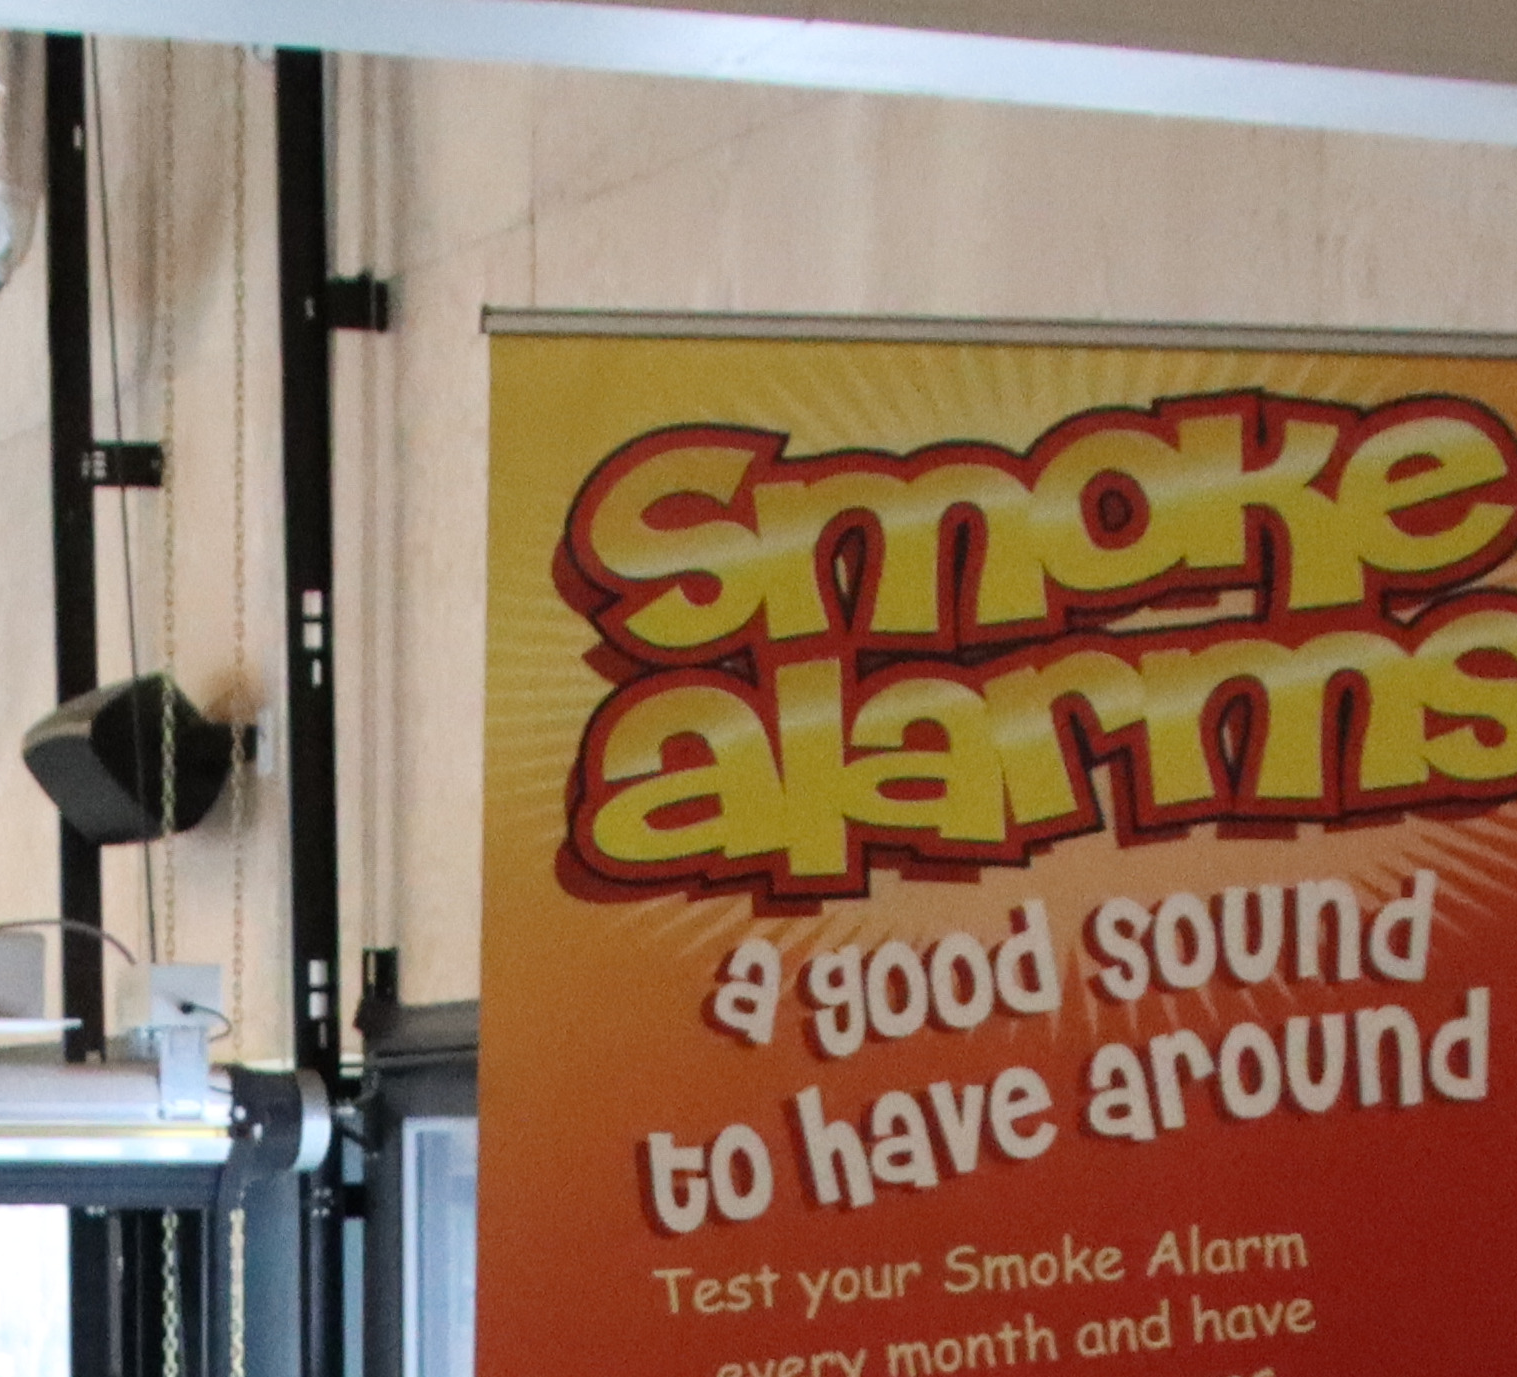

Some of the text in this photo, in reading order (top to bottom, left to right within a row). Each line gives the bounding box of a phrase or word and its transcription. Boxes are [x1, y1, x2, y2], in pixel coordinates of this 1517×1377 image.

[712, 871, 1437, 1057] a good sound
[648, 988, 1491, 1234] to have around
[654, 1225, 1308, 1319] Test your Smoke Alarm
[889, 1323, 1056, 1377] month
[1077, 1304, 1170, 1356] and
[1193, 1290, 1317, 1344] have
